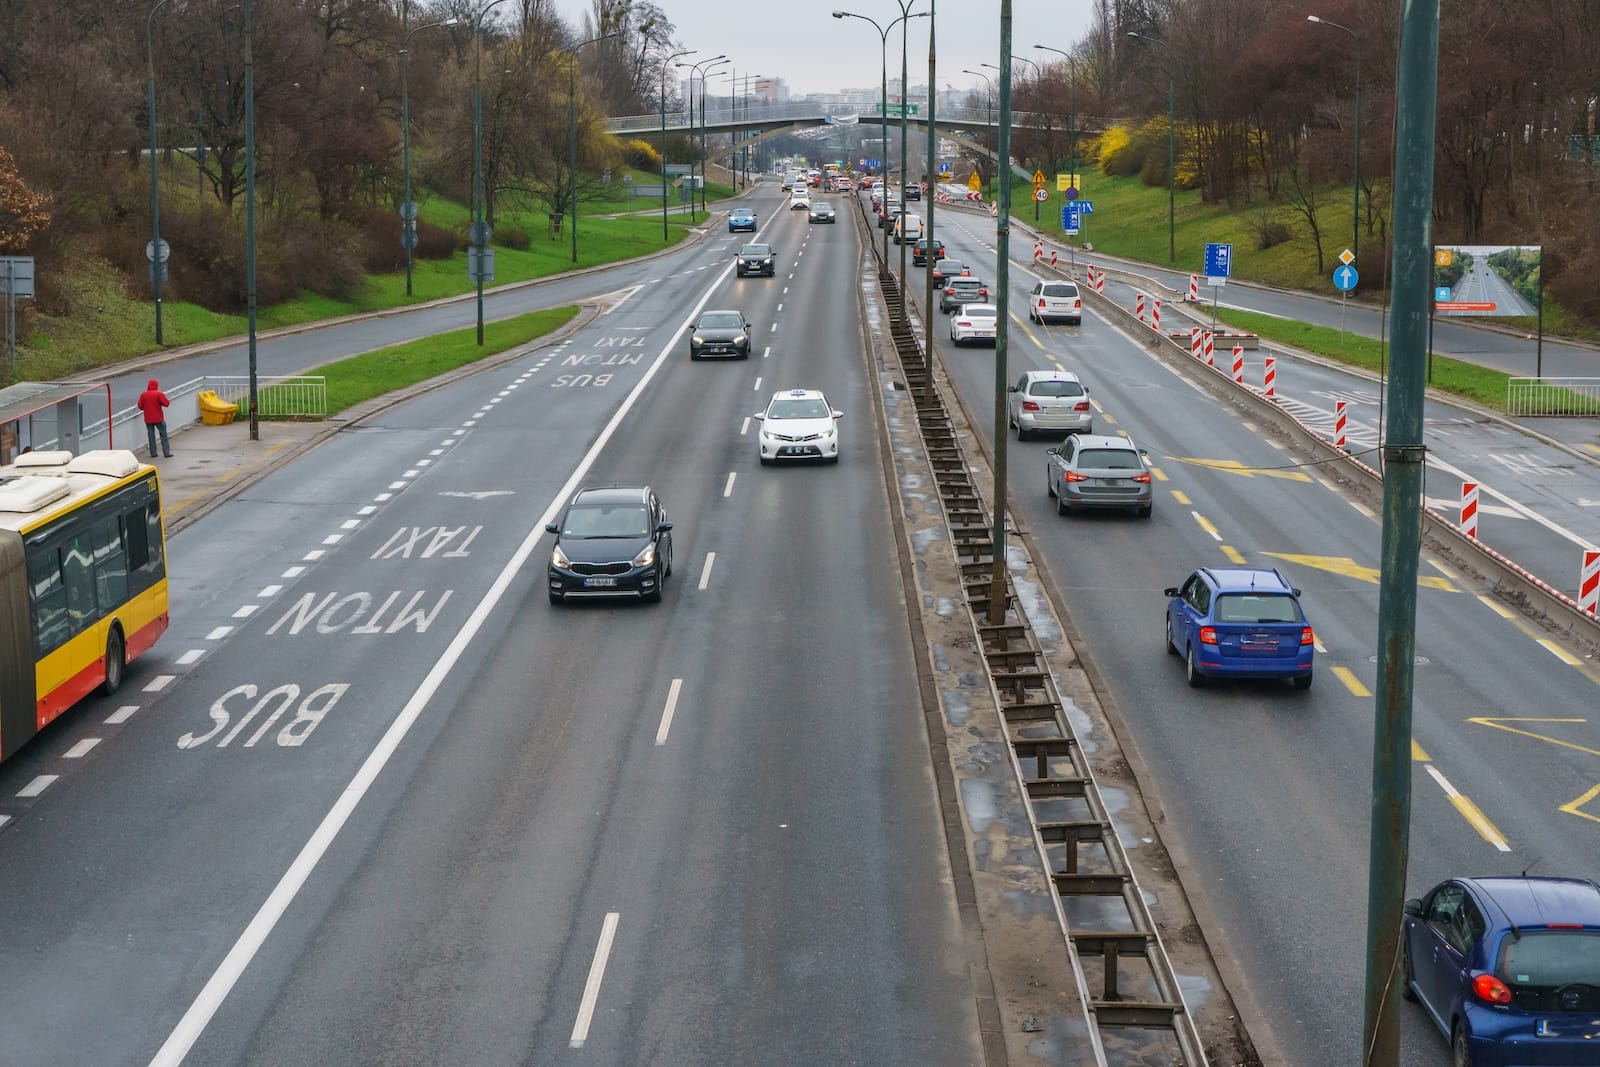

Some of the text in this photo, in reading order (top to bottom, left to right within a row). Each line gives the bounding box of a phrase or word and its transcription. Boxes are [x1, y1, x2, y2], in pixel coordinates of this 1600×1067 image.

[1037, 191, 1046, 199] 40
[593, 337, 646, 347] TAXI
[561, 353, 645, 366] MTON
[551, 374, 614, 388] BUS
[370, 525, 484, 559] TAXI
[264, 590, 454, 635] MTON
[177, 683, 351, 749] BUS
